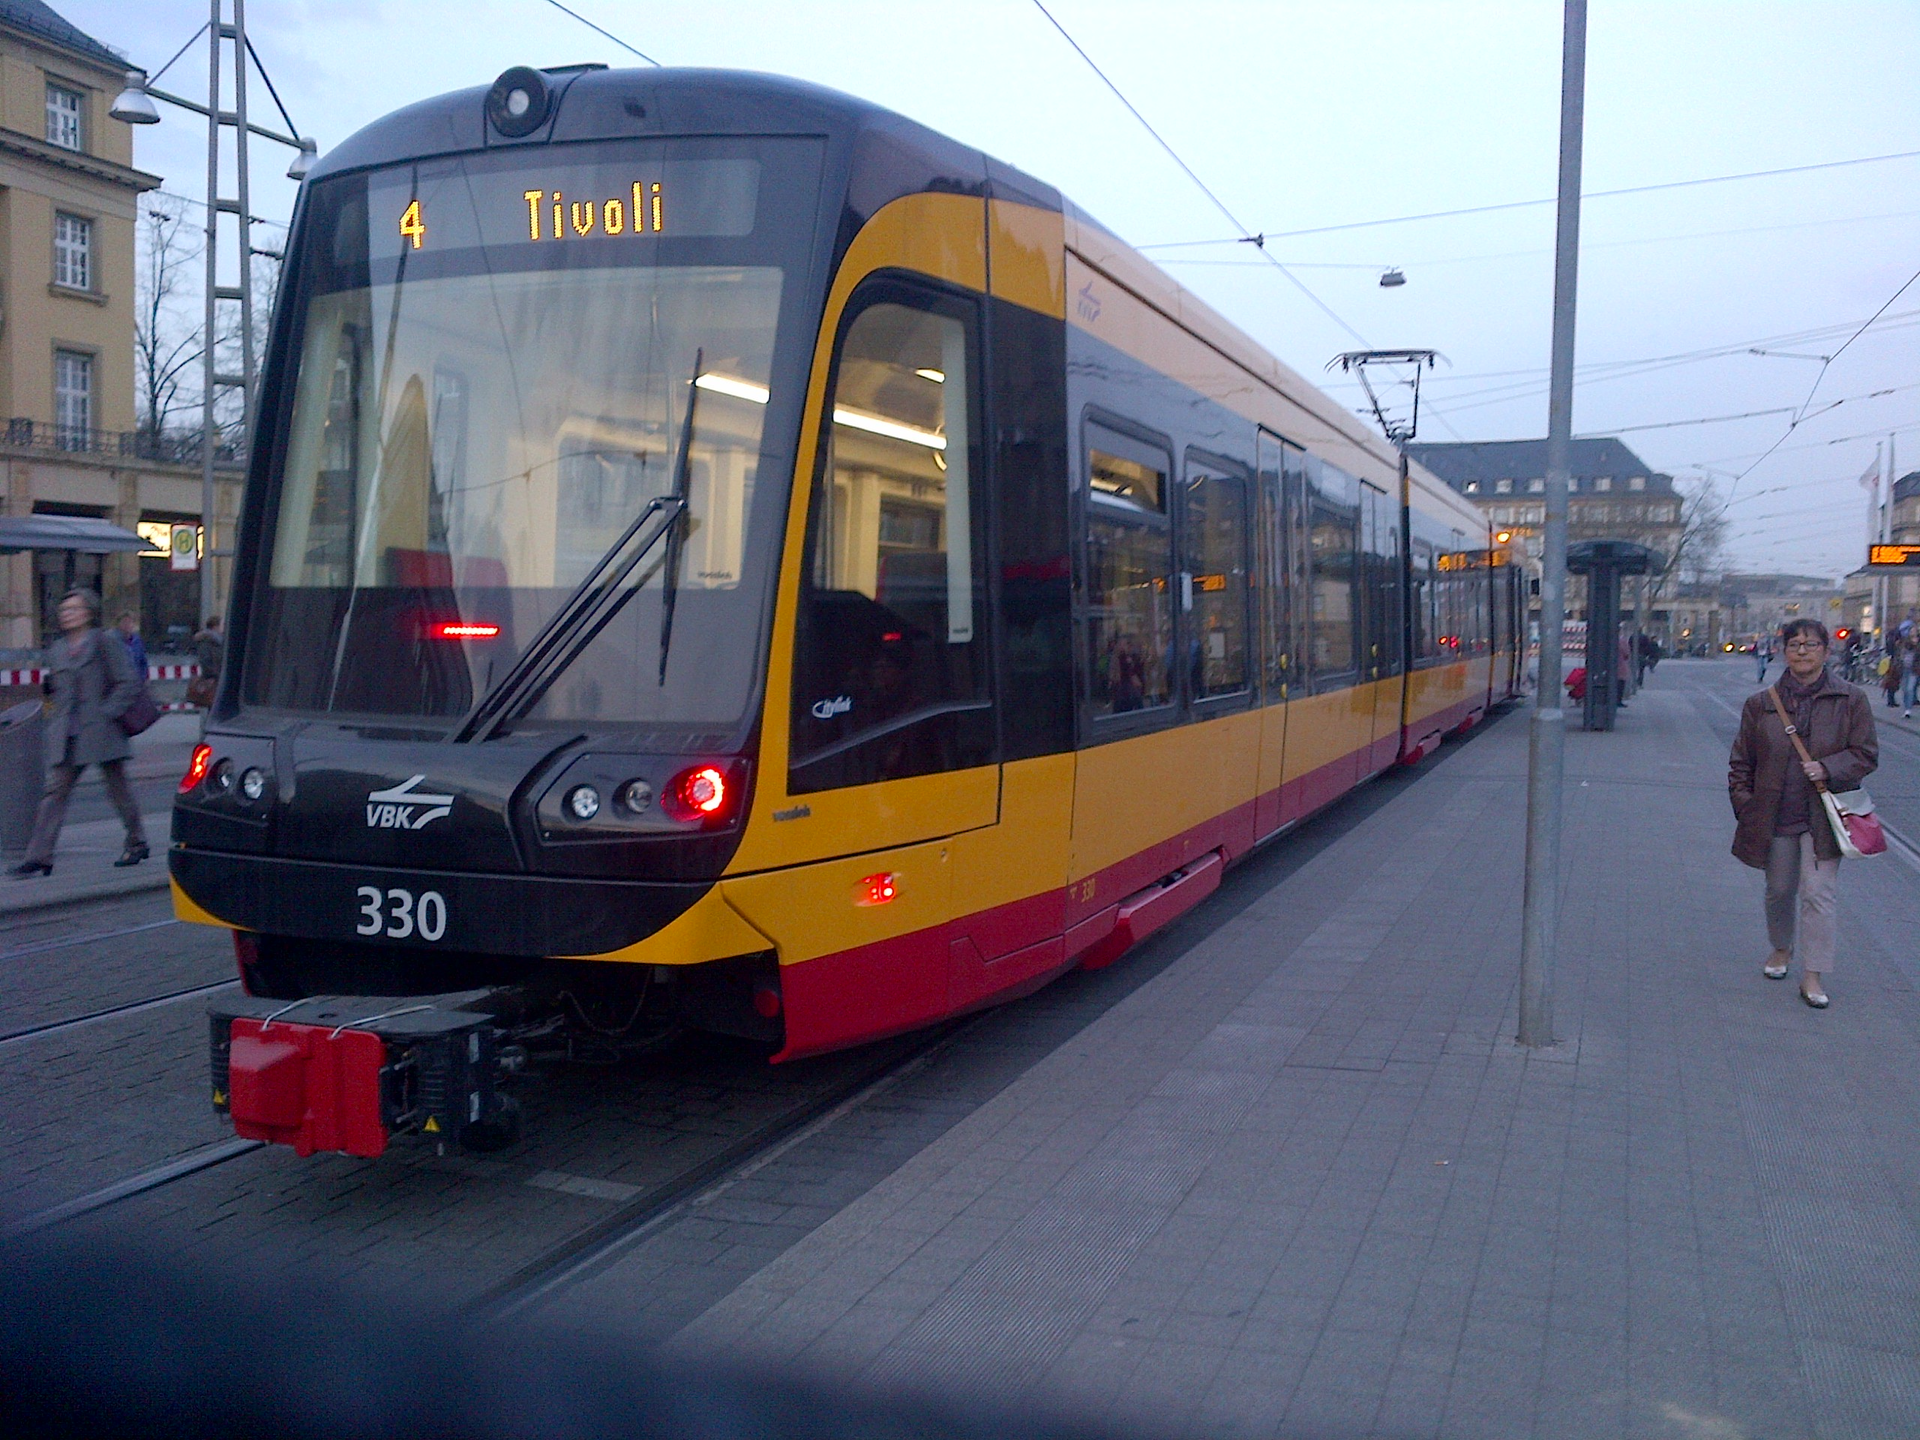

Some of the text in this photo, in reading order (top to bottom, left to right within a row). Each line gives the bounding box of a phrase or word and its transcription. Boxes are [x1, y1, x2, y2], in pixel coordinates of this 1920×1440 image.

[399, 181, 662, 249] 4 Tivoli
[366, 804, 415, 829] VBK
[356, 885, 447, 942] 330
